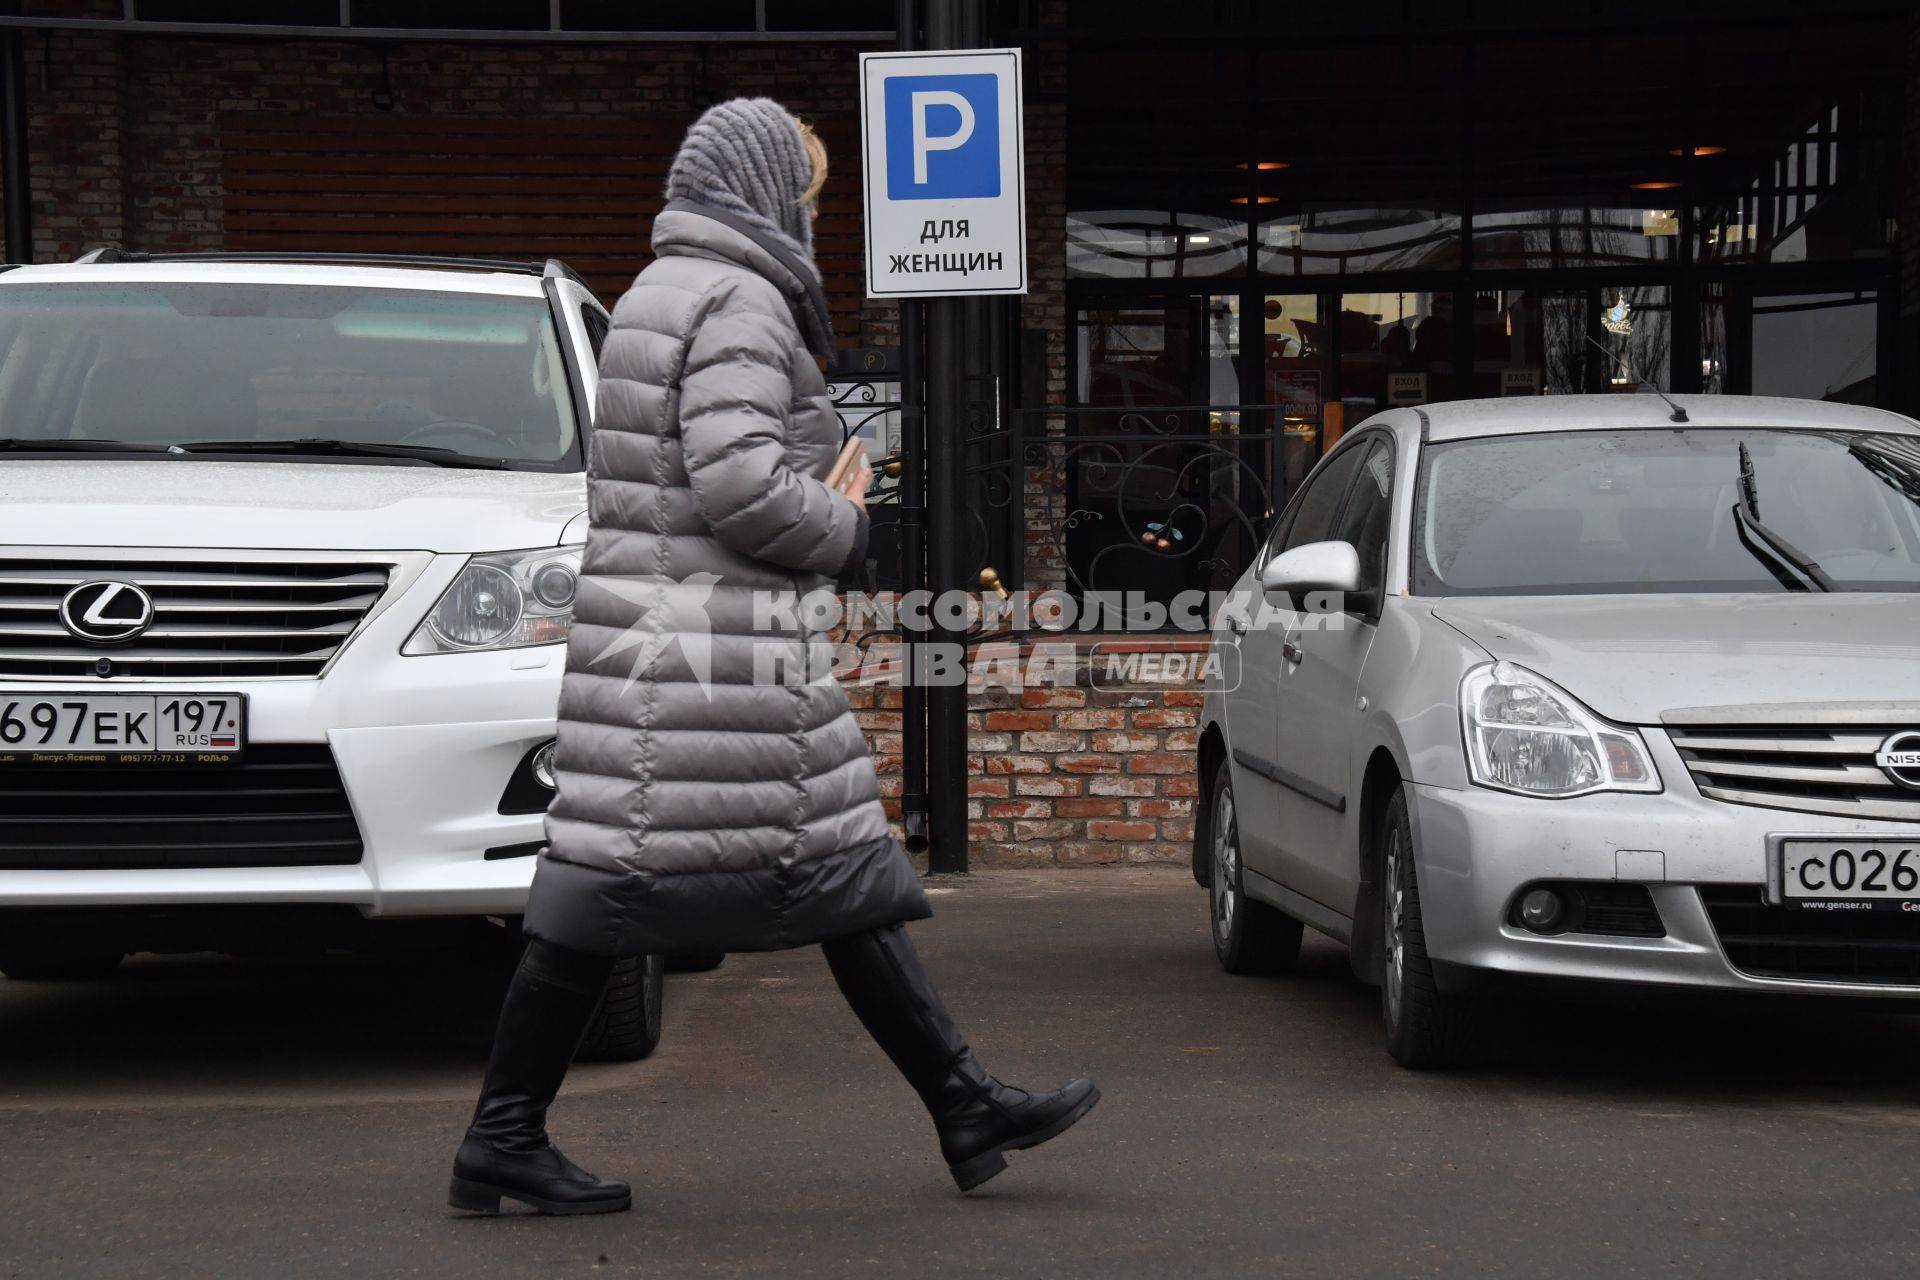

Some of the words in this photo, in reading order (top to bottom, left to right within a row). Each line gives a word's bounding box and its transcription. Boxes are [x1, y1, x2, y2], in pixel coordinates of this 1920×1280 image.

[912, 90, 976, 185] P
[920, 219, 970, 244] ДЛЯ
[889, 251, 1003, 276] ЖЕНЩИН
[1394, 377, 1420, 386] ВХОД
[1507, 373, 1534, 384] ВХОД
[162, 700, 228, 732] 197
[176, 734, 209, 746] RUS
[198, 754, 229, 762] РОЛЬФ
[1802, 901, 1873, 911] www.genser.ru
[1902, 901, 1920, 912] Ge
